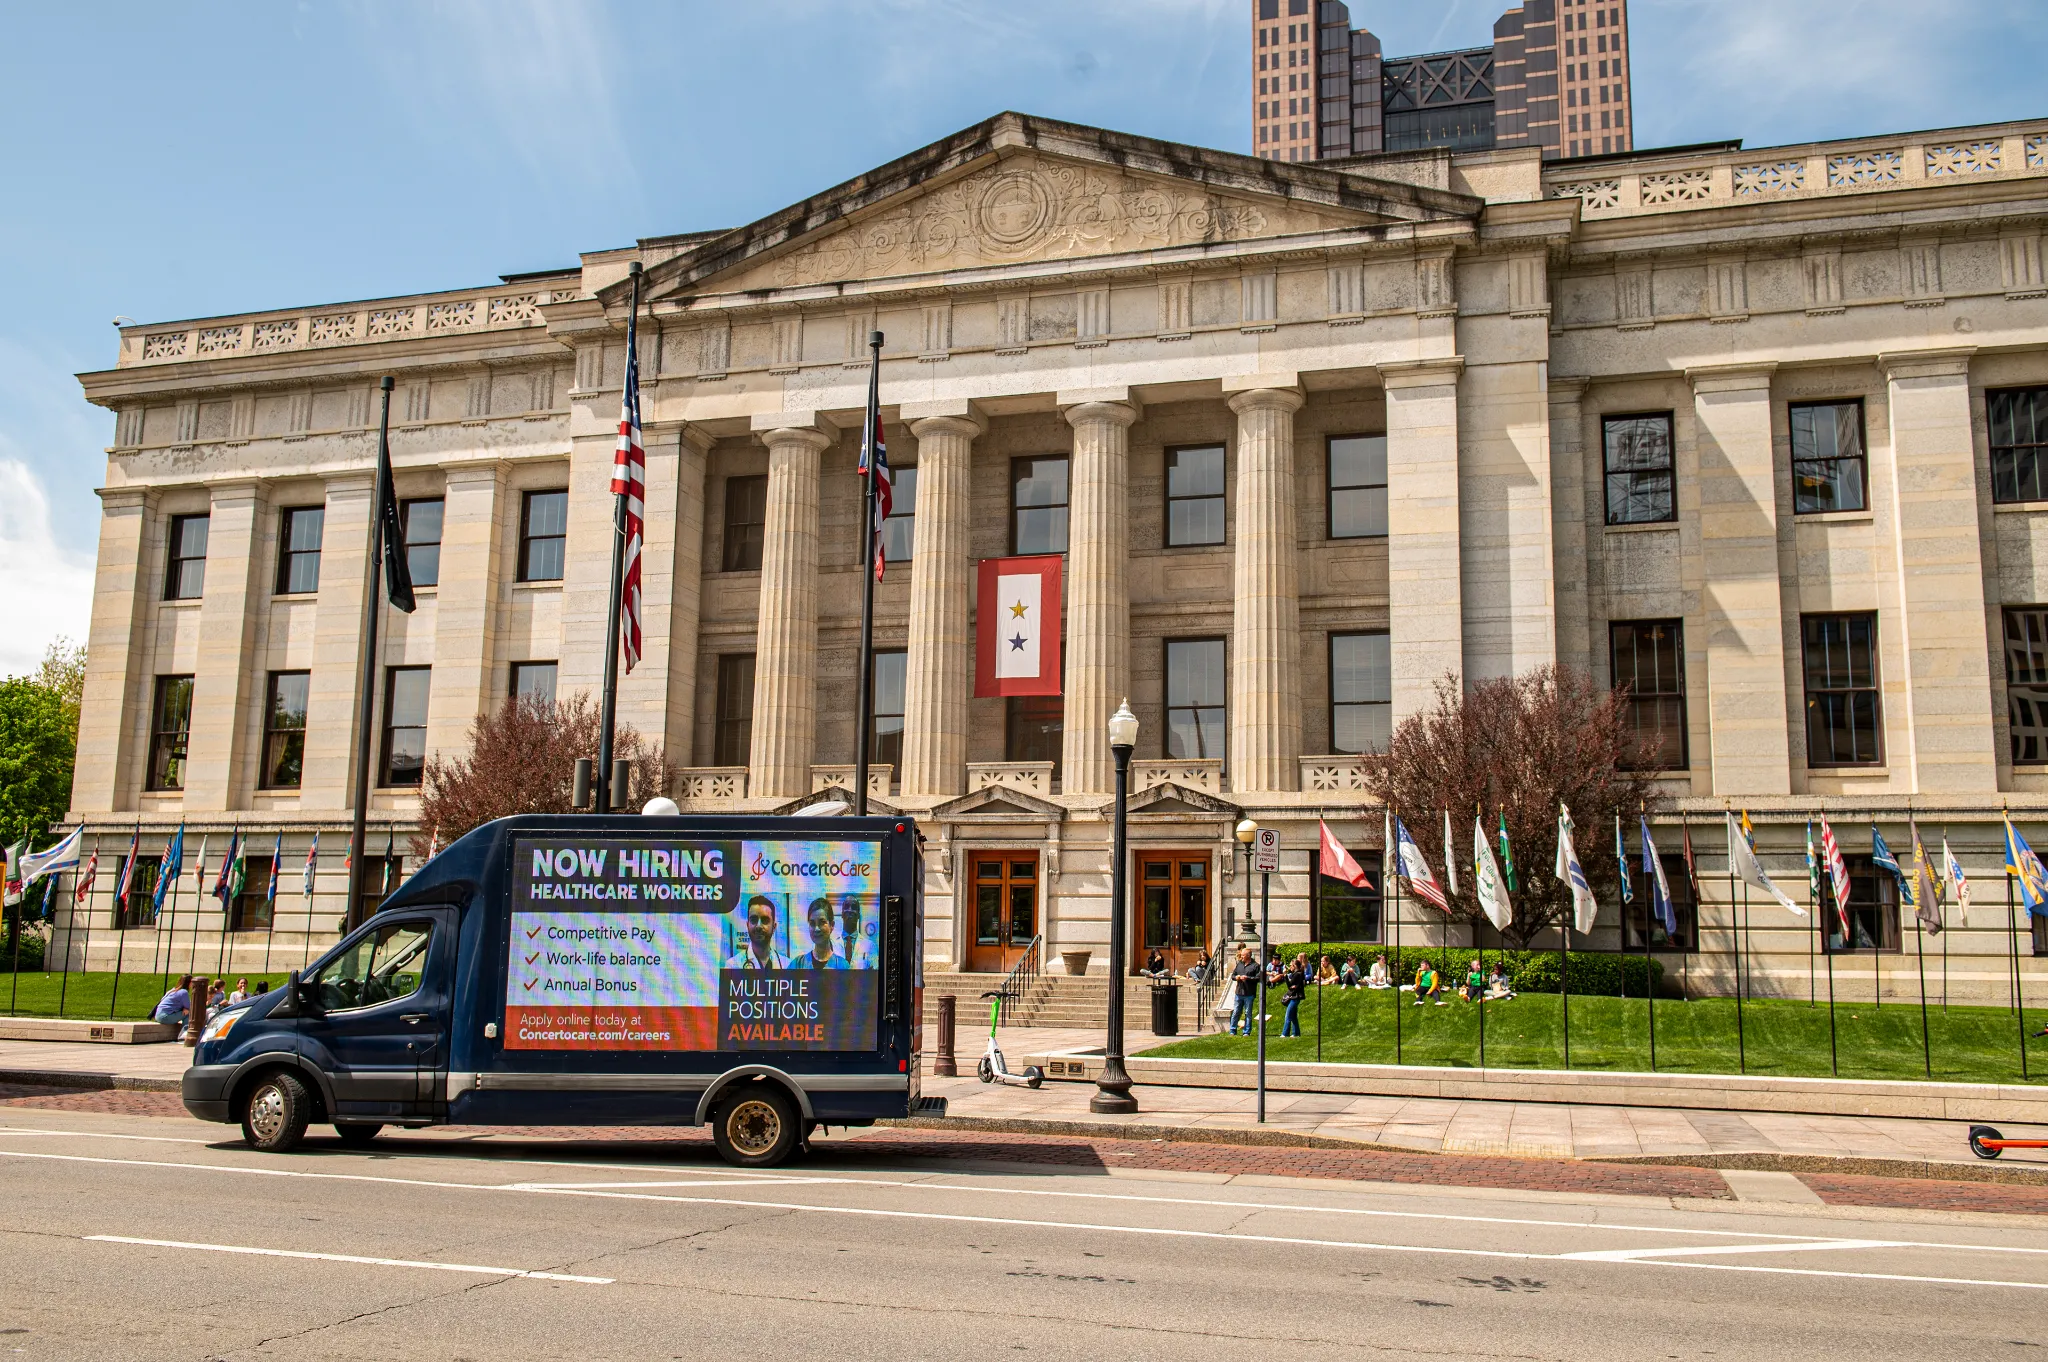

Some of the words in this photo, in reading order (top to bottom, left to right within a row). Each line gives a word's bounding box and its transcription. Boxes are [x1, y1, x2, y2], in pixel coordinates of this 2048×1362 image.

[532, 848, 607, 878] NOW
[618, 849, 724, 879] HIRING
[771, 859, 870, 877] ConcertoCare
[530, 883, 638, 900] HEALTHCARE
[642, 883, 723, 901] WORKERS
[547, 926, 628, 942] Competitive
[631, 926, 656, 943] Pay
[546, 951, 607, 966] Work-life
[609, 952, 661, 966] balance
[544, 977, 592, 992] Annual
[595, 978, 637, 992] Bonus
[729, 979, 809, 997] MULTIPLE
[728, 1001, 819, 1019] POSITIONS
[520, 1012, 553, 1028] Apply
[556, 1013, 591, 1026] online
[594, 1014, 627, 1028] today
[630, 1014, 642, 1026] at
[518, 1027, 671, 1041] Concertocare.com/careers
[727, 1023, 824, 1041] AVAILABLE
